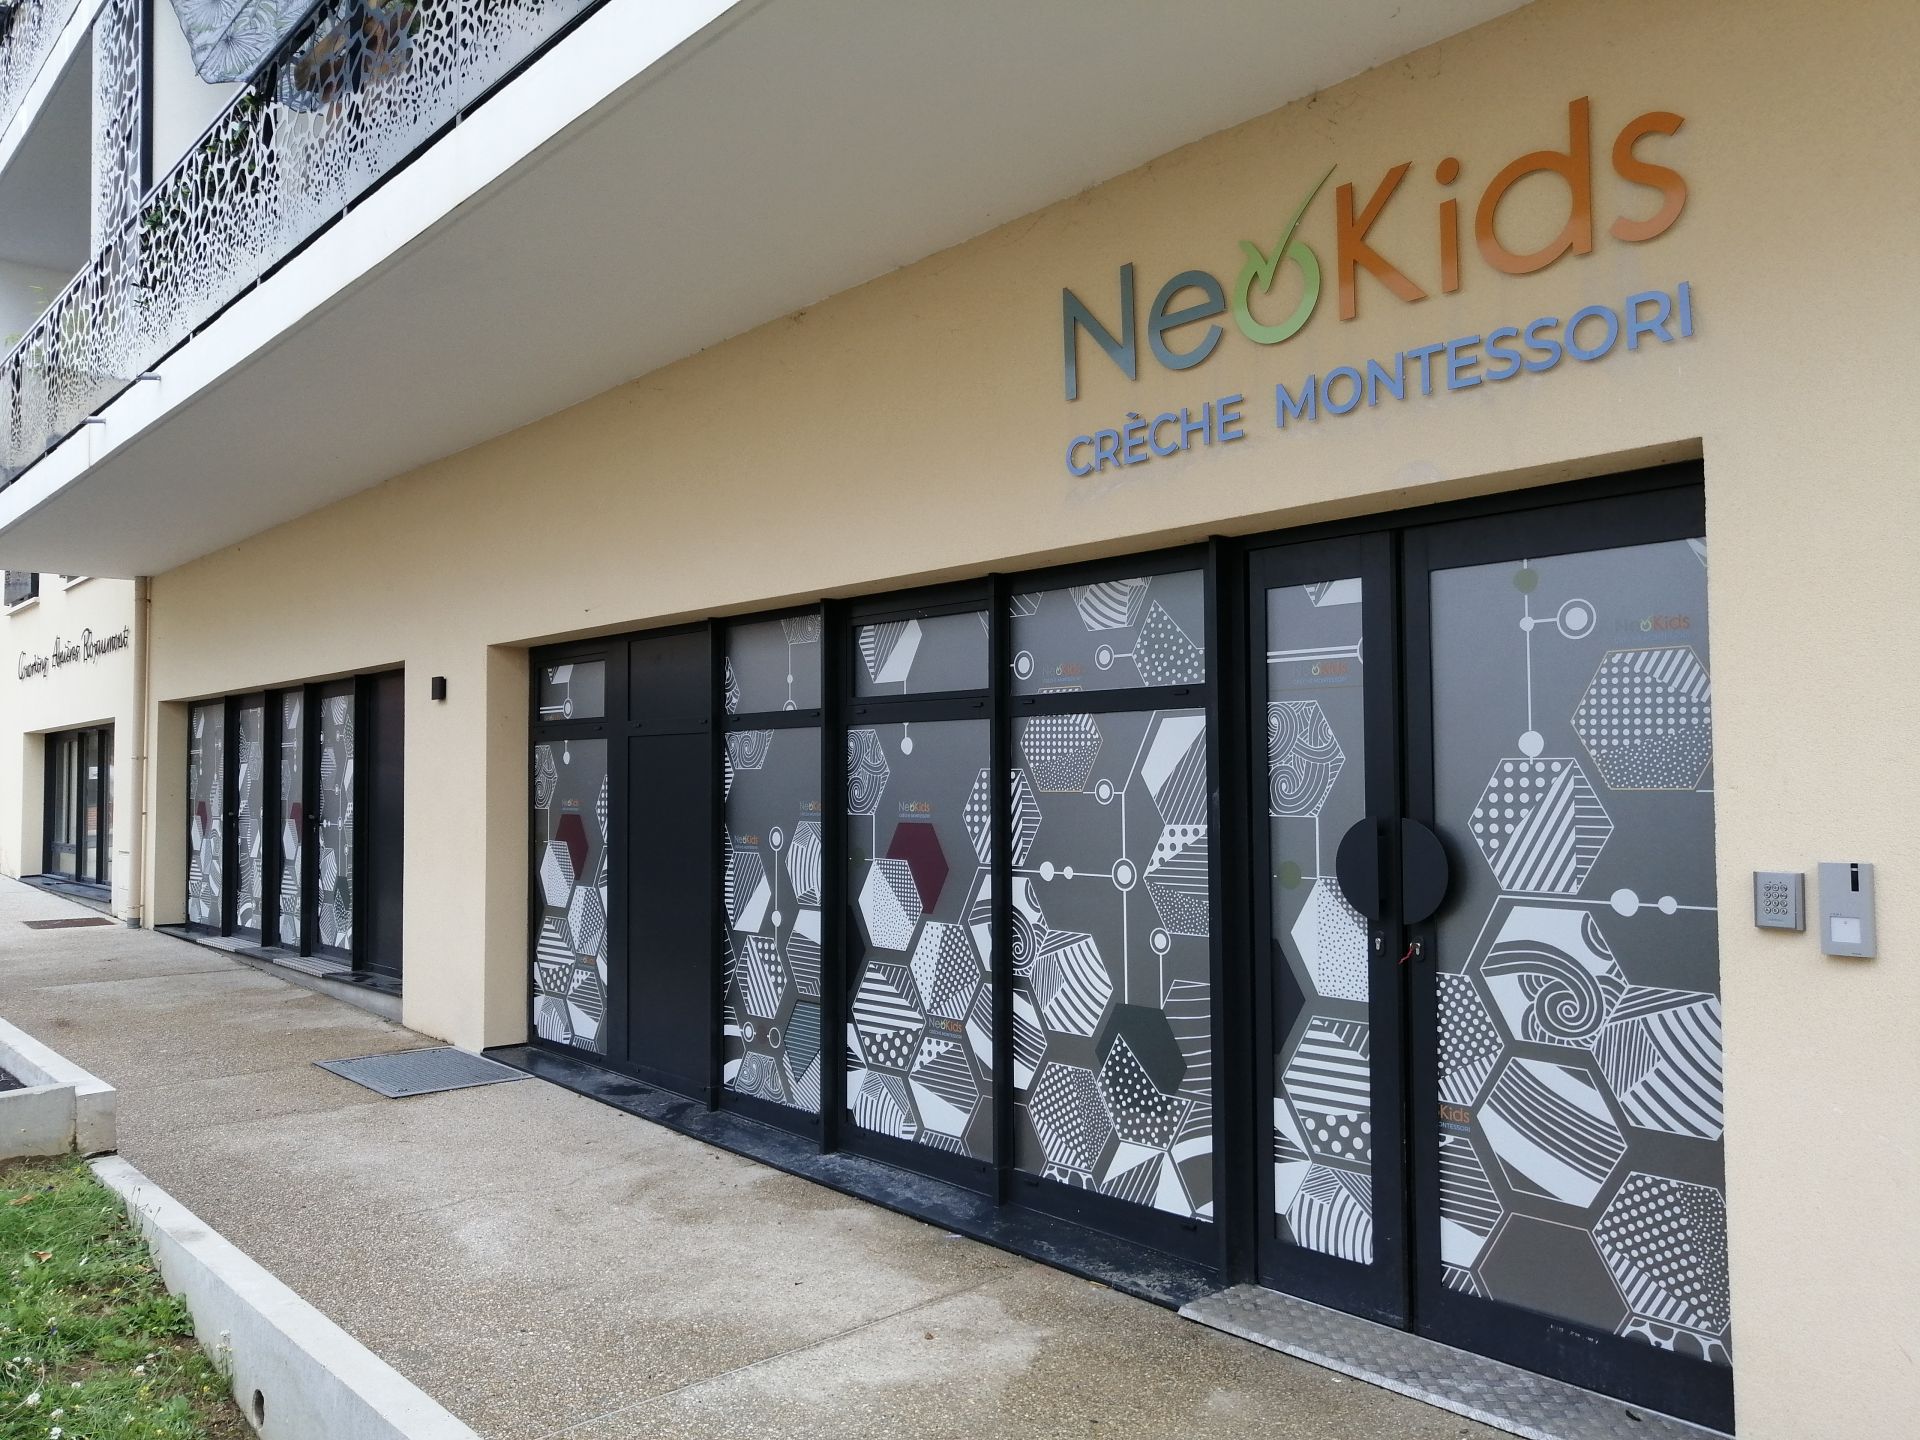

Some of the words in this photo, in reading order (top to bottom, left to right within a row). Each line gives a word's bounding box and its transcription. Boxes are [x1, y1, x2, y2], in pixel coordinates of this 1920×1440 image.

[1062, 95, 1688, 401] NeoKids
[1065, 394, 1245, 478] CRÈCHE
[1275, 280, 1695, 430] MONTESSORI
[928, 1016, 962, 1033] NeoKids
